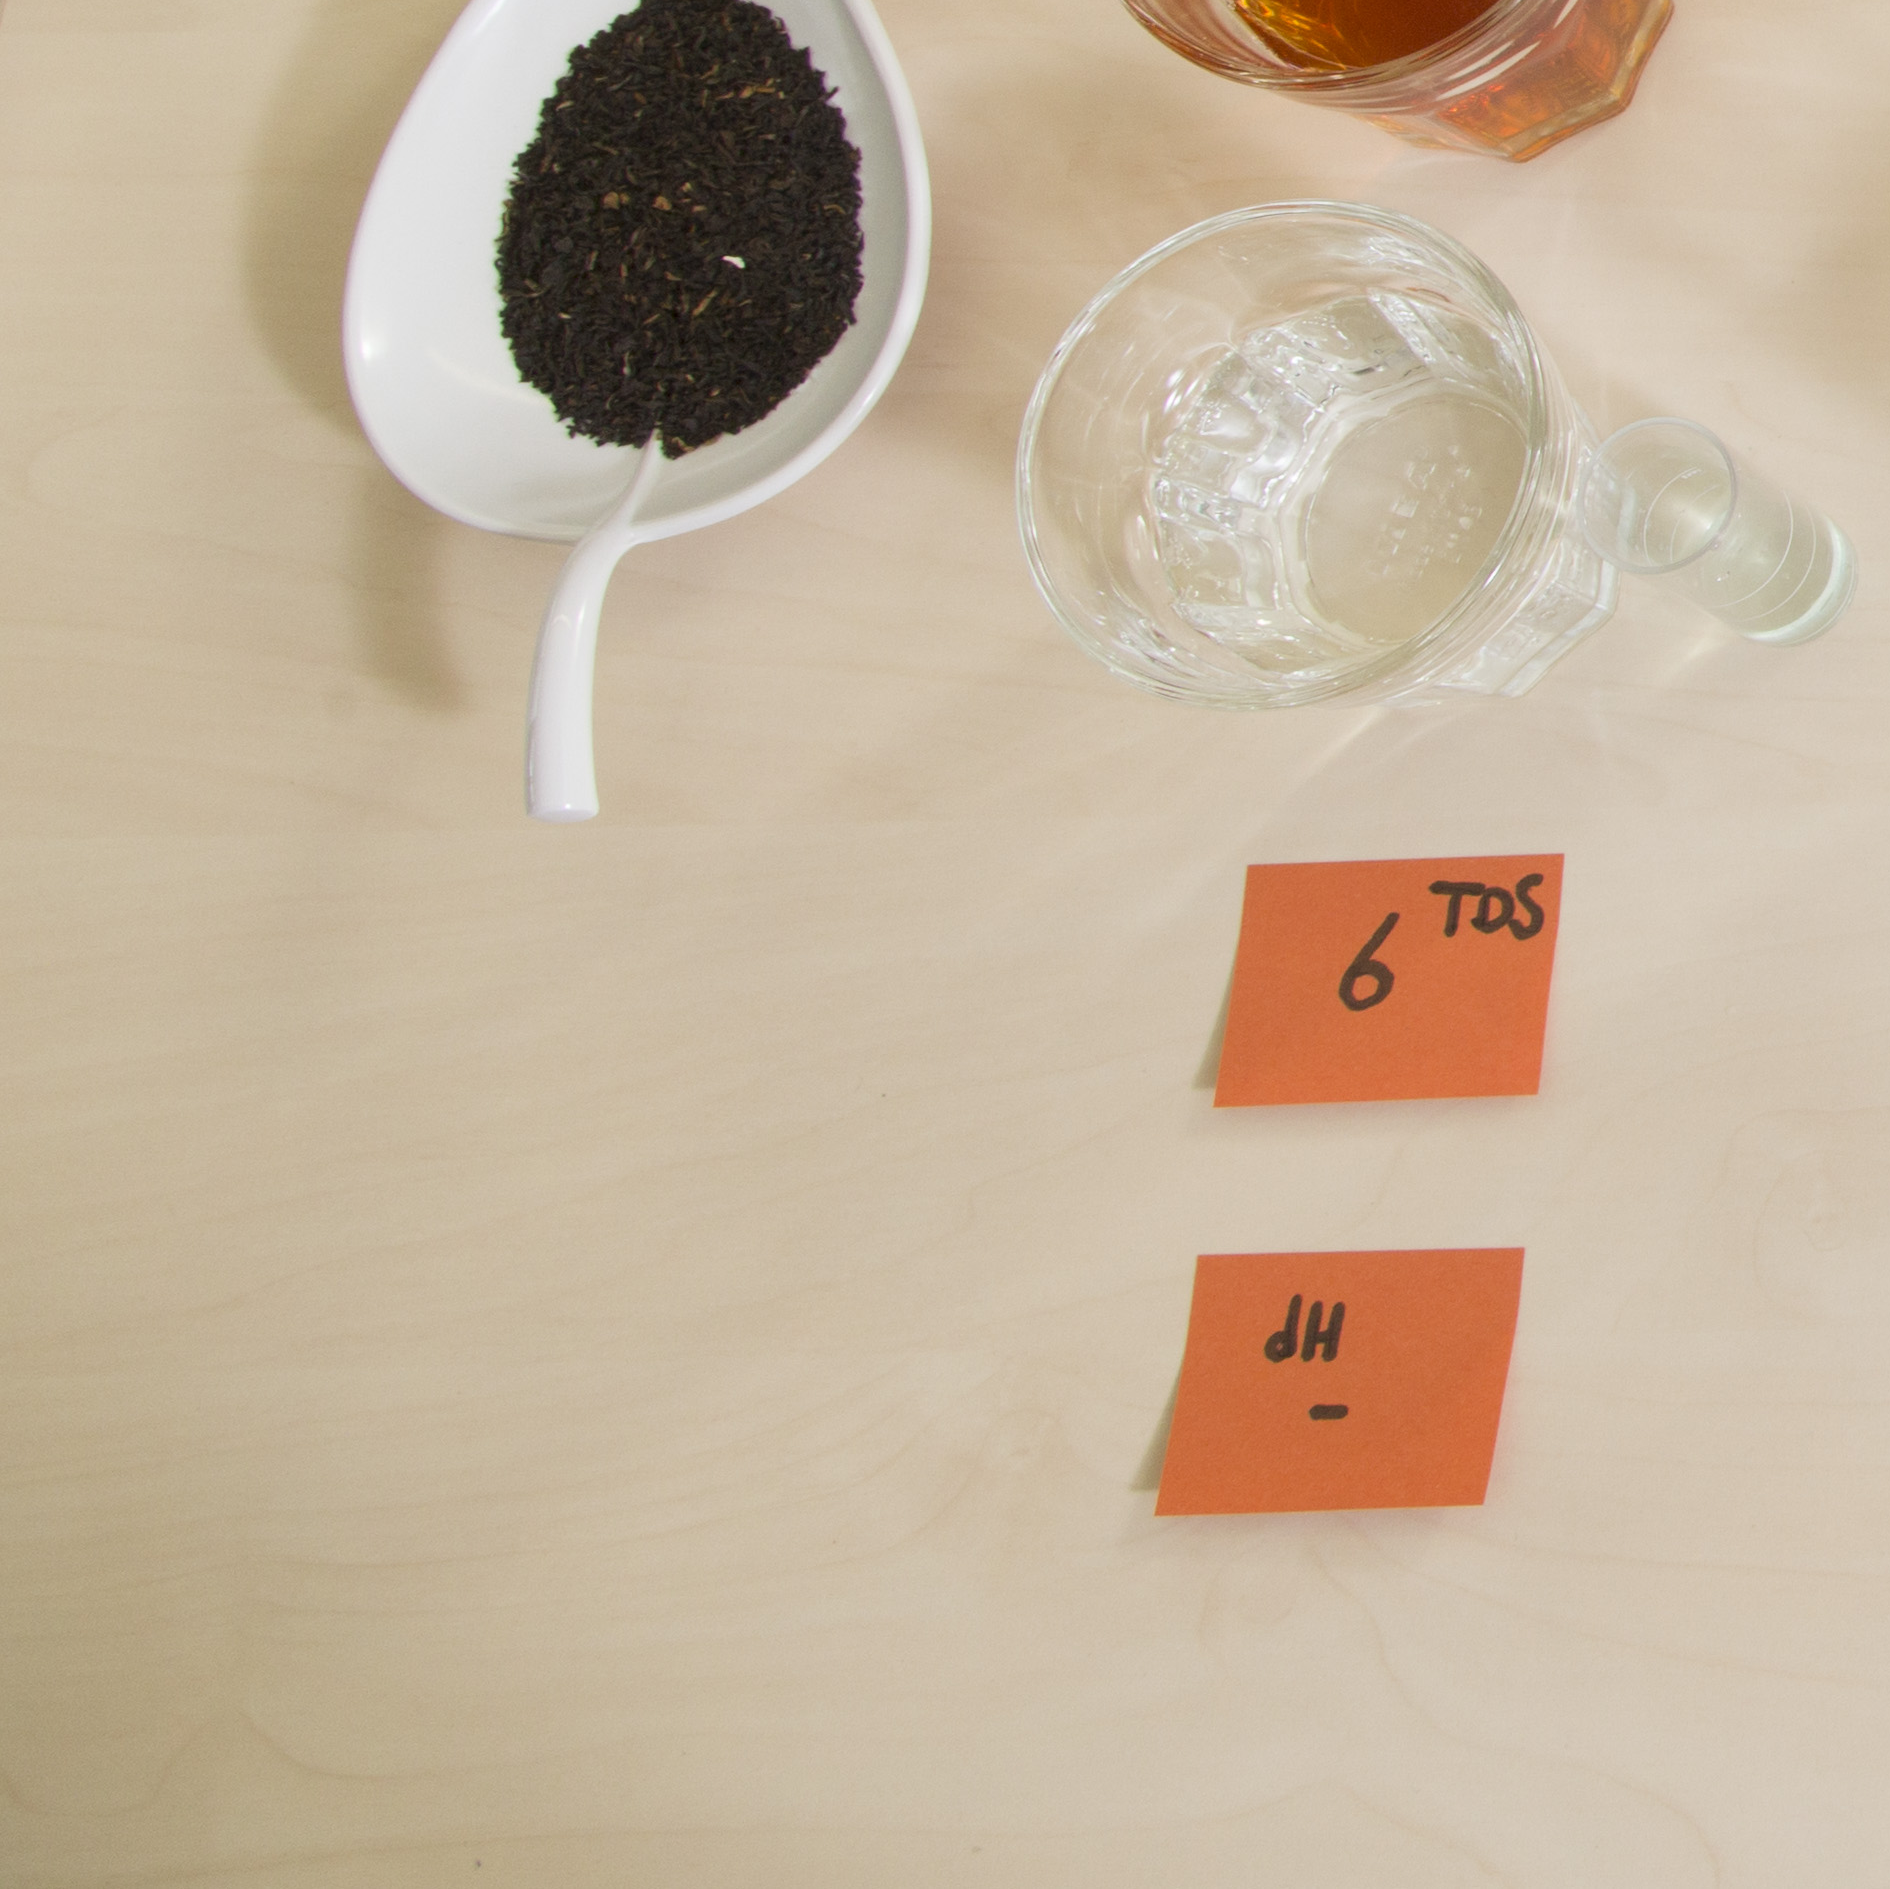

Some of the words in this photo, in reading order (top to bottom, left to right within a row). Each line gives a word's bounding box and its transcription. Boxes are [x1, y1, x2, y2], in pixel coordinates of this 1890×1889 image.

[1429, 873, 1545, 940] TDS
[1338, 912, 1400, 1012] 6
[1263, 1293, 1346, 1364] dH
